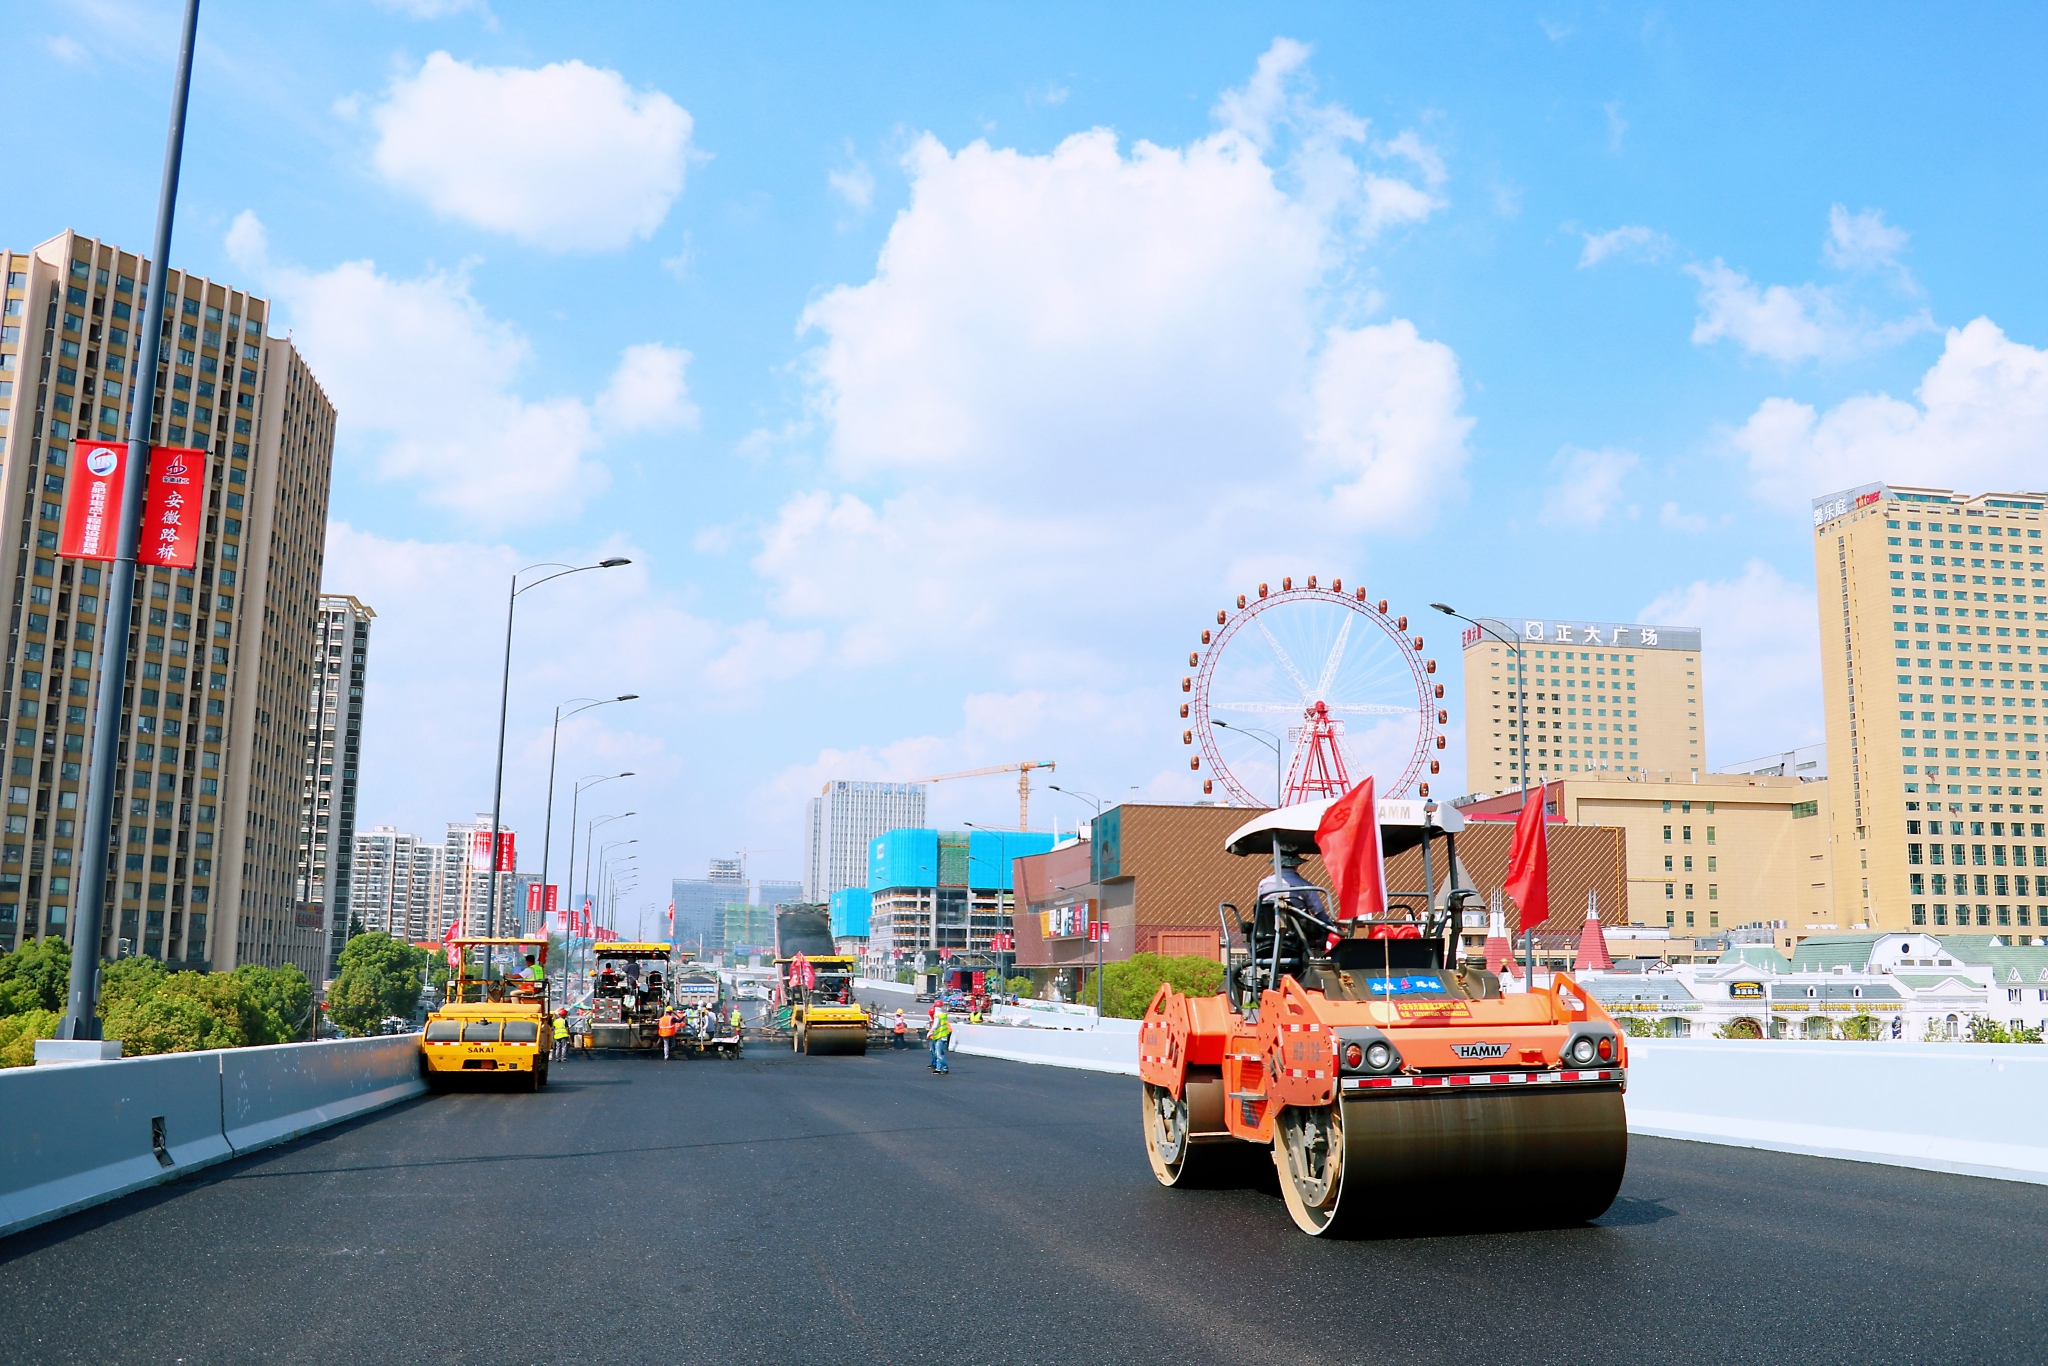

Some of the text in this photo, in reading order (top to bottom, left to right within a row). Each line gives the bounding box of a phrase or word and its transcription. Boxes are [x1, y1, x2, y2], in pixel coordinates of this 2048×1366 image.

[156, 491, 184, 560] 安徽路桥
[1555, 624, 1658, 646] 正大广场
[1379, 805, 1411, 819] AMM
[1461, 1046, 1502, 1057] HAMM
